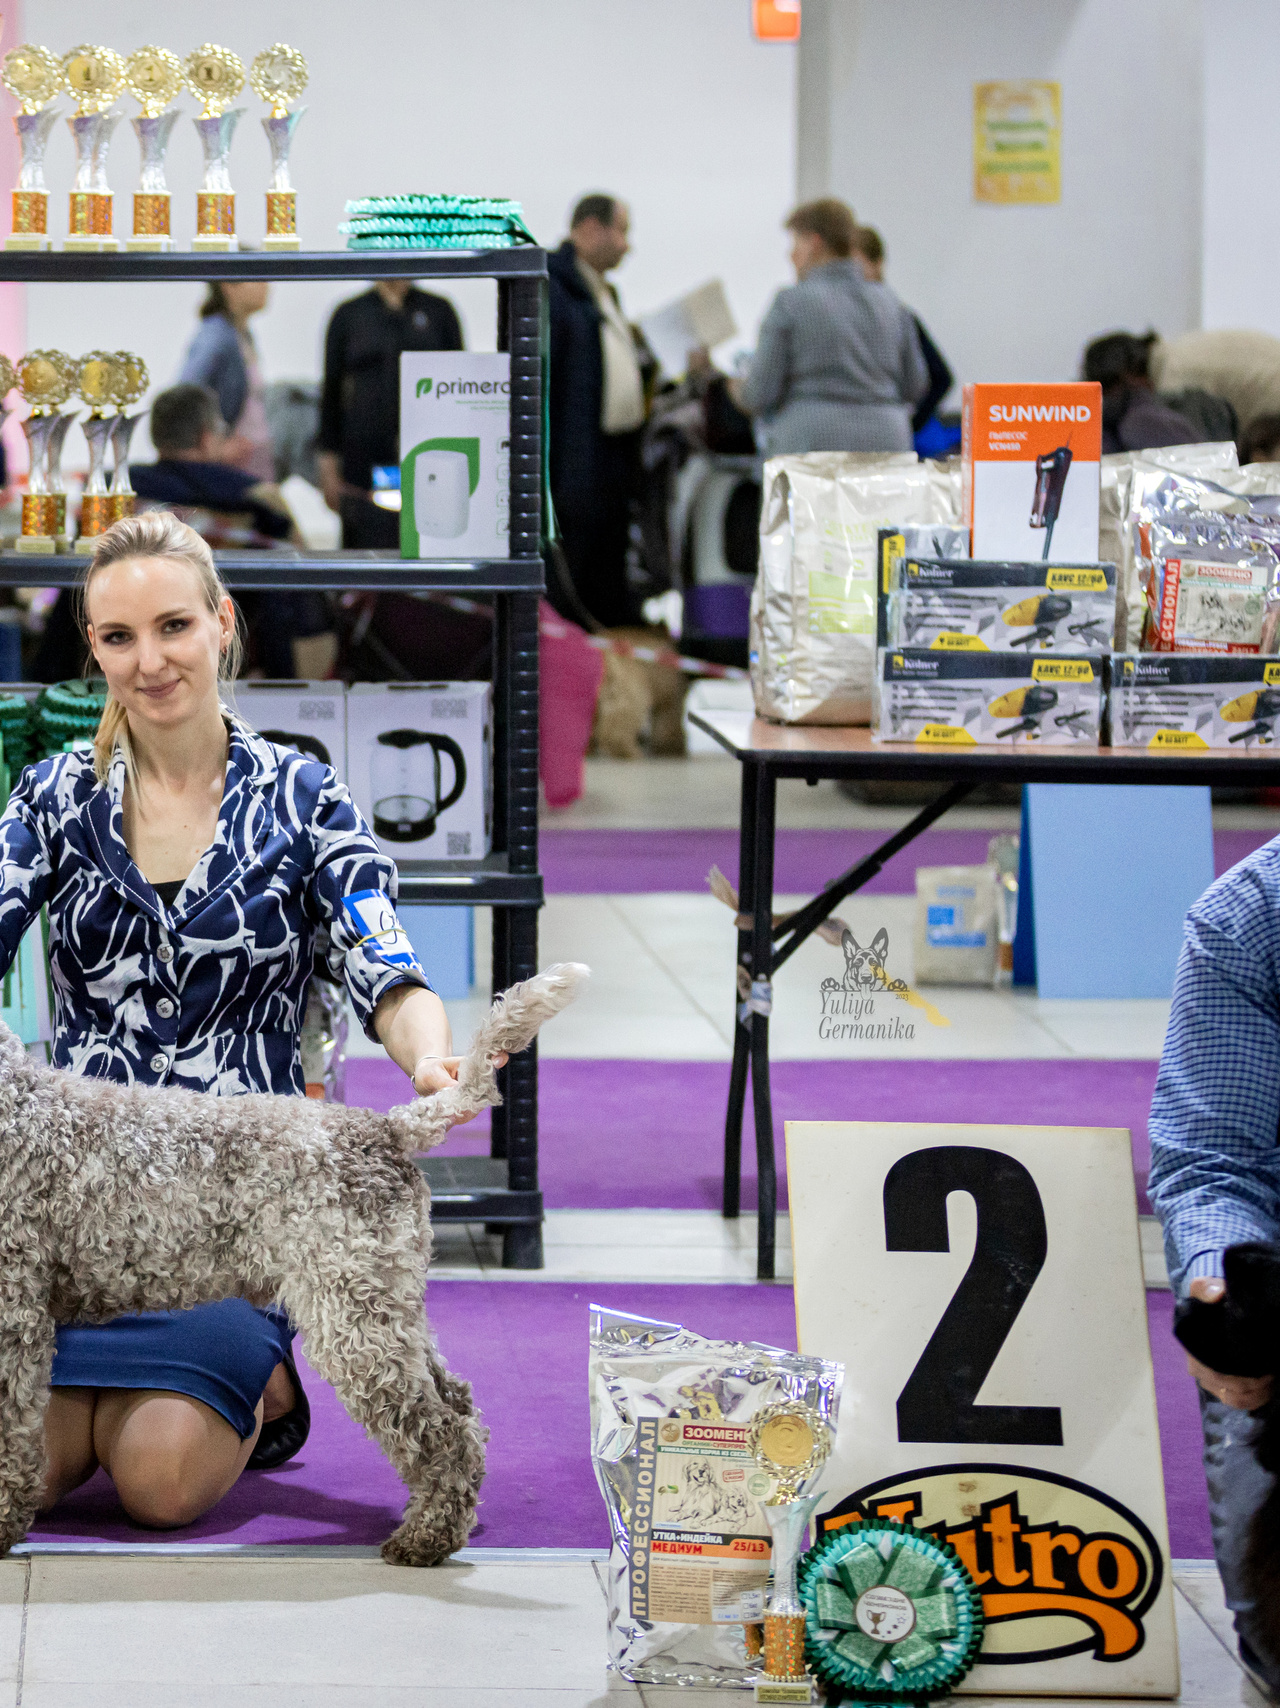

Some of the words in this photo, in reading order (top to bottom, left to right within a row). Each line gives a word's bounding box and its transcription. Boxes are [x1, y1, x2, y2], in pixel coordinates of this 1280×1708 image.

[988, 404, 1091, 422] SUNWIND
[1199, 567, 1252, 581] ЗООМЕНЮ
[1135, 663, 1170, 675] Kölner
[883, 1145, 1064, 1446] 2
[684, 1427, 745, 1442] ЗООМЕН
[631, 1421, 657, 1616] ПРОФЕССИОНАЛ
[652, 1542, 703, 1555] МЕДИУМ
[733, 1541, 765, 1553] 25/13
